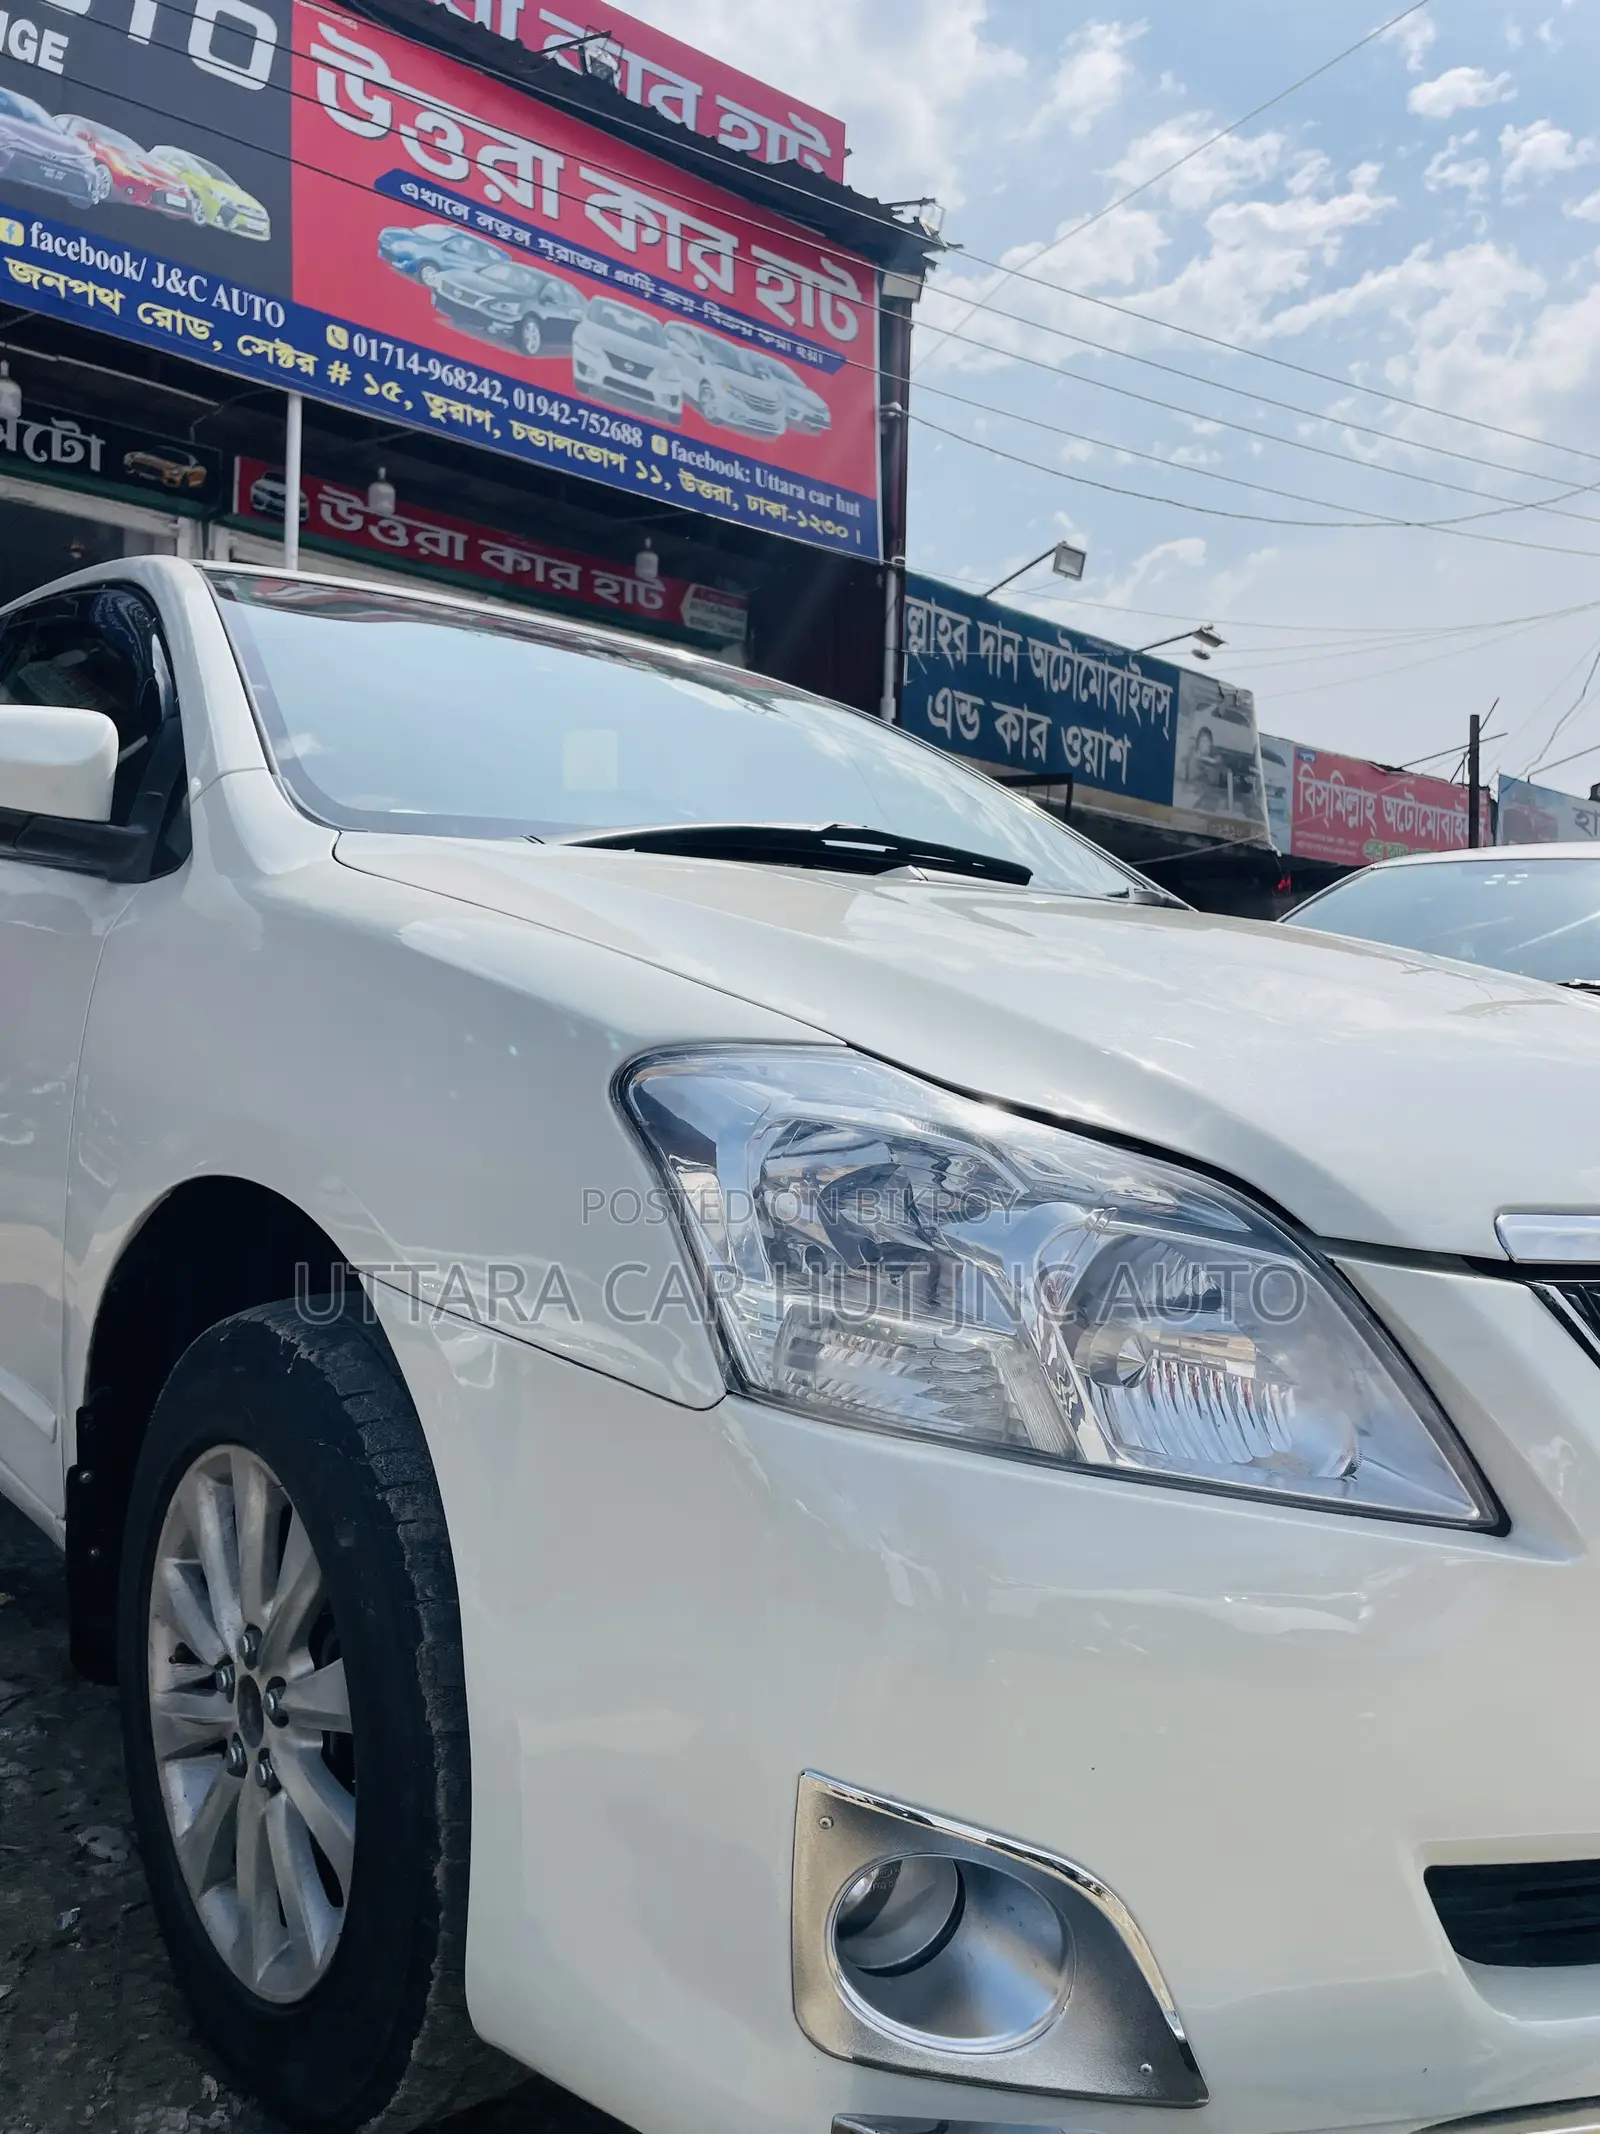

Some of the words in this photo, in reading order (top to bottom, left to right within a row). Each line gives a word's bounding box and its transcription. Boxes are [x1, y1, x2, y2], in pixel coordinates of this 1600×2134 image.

[29, 221, 148, 282] facebook/
[151, 261, 209, 303] J&C
[211, 284, 286, 329] AUTO
[400, 182, 471, 221] এখানে
[475, 211, 532, 246] নতুন
[538, 236, 609, 277] পুরাতন
[580, 166, 739, 297] কার
[751, 244, 864, 343] হাট
[3, 256, 126, 317] জনপথ
[237, 334, 319, 377] সেক্টর
[327, 359, 352, 387] #
[421, 390, 502, 440] তুরাগ,
[352, 332, 510, 410] 01714-968242,
[512, 387, 644, 449] 01942-752688
[671, 440, 751, 484] facebook:
[755, 467, 806, 501] Uttara
[808, 486, 834, 509] car
[836, 492, 861, 519] hut
[478, 538, 582, 592] কার
[591, 569, 666, 610] হাট
[977, 620, 1023, 684] দান
[991, 700, 1053, 764] কার
[1061, 724, 1132, 786] ওয়াশ
